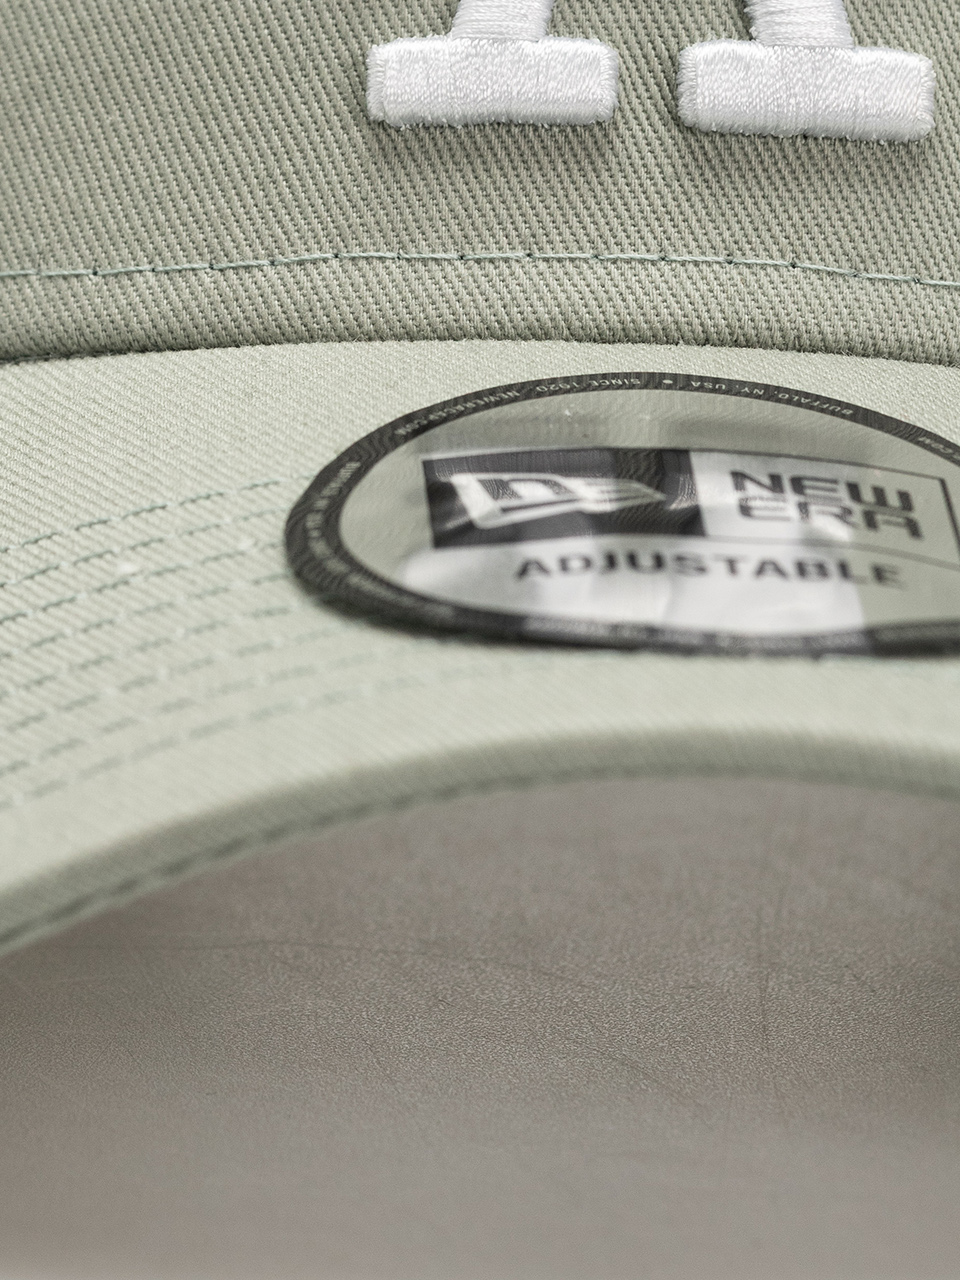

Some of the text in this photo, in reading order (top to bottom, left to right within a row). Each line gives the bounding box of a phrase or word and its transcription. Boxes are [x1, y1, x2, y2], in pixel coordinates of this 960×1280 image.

[535, 381, 580, 393] 1920
[589, 377, 641, 388] SINCE
[690, 380, 726, 390] USA
[730, 470, 914, 517] NEW
[739, 495, 924, 541] ERA
[515, 547, 906, 586] ADJUSTABLE
